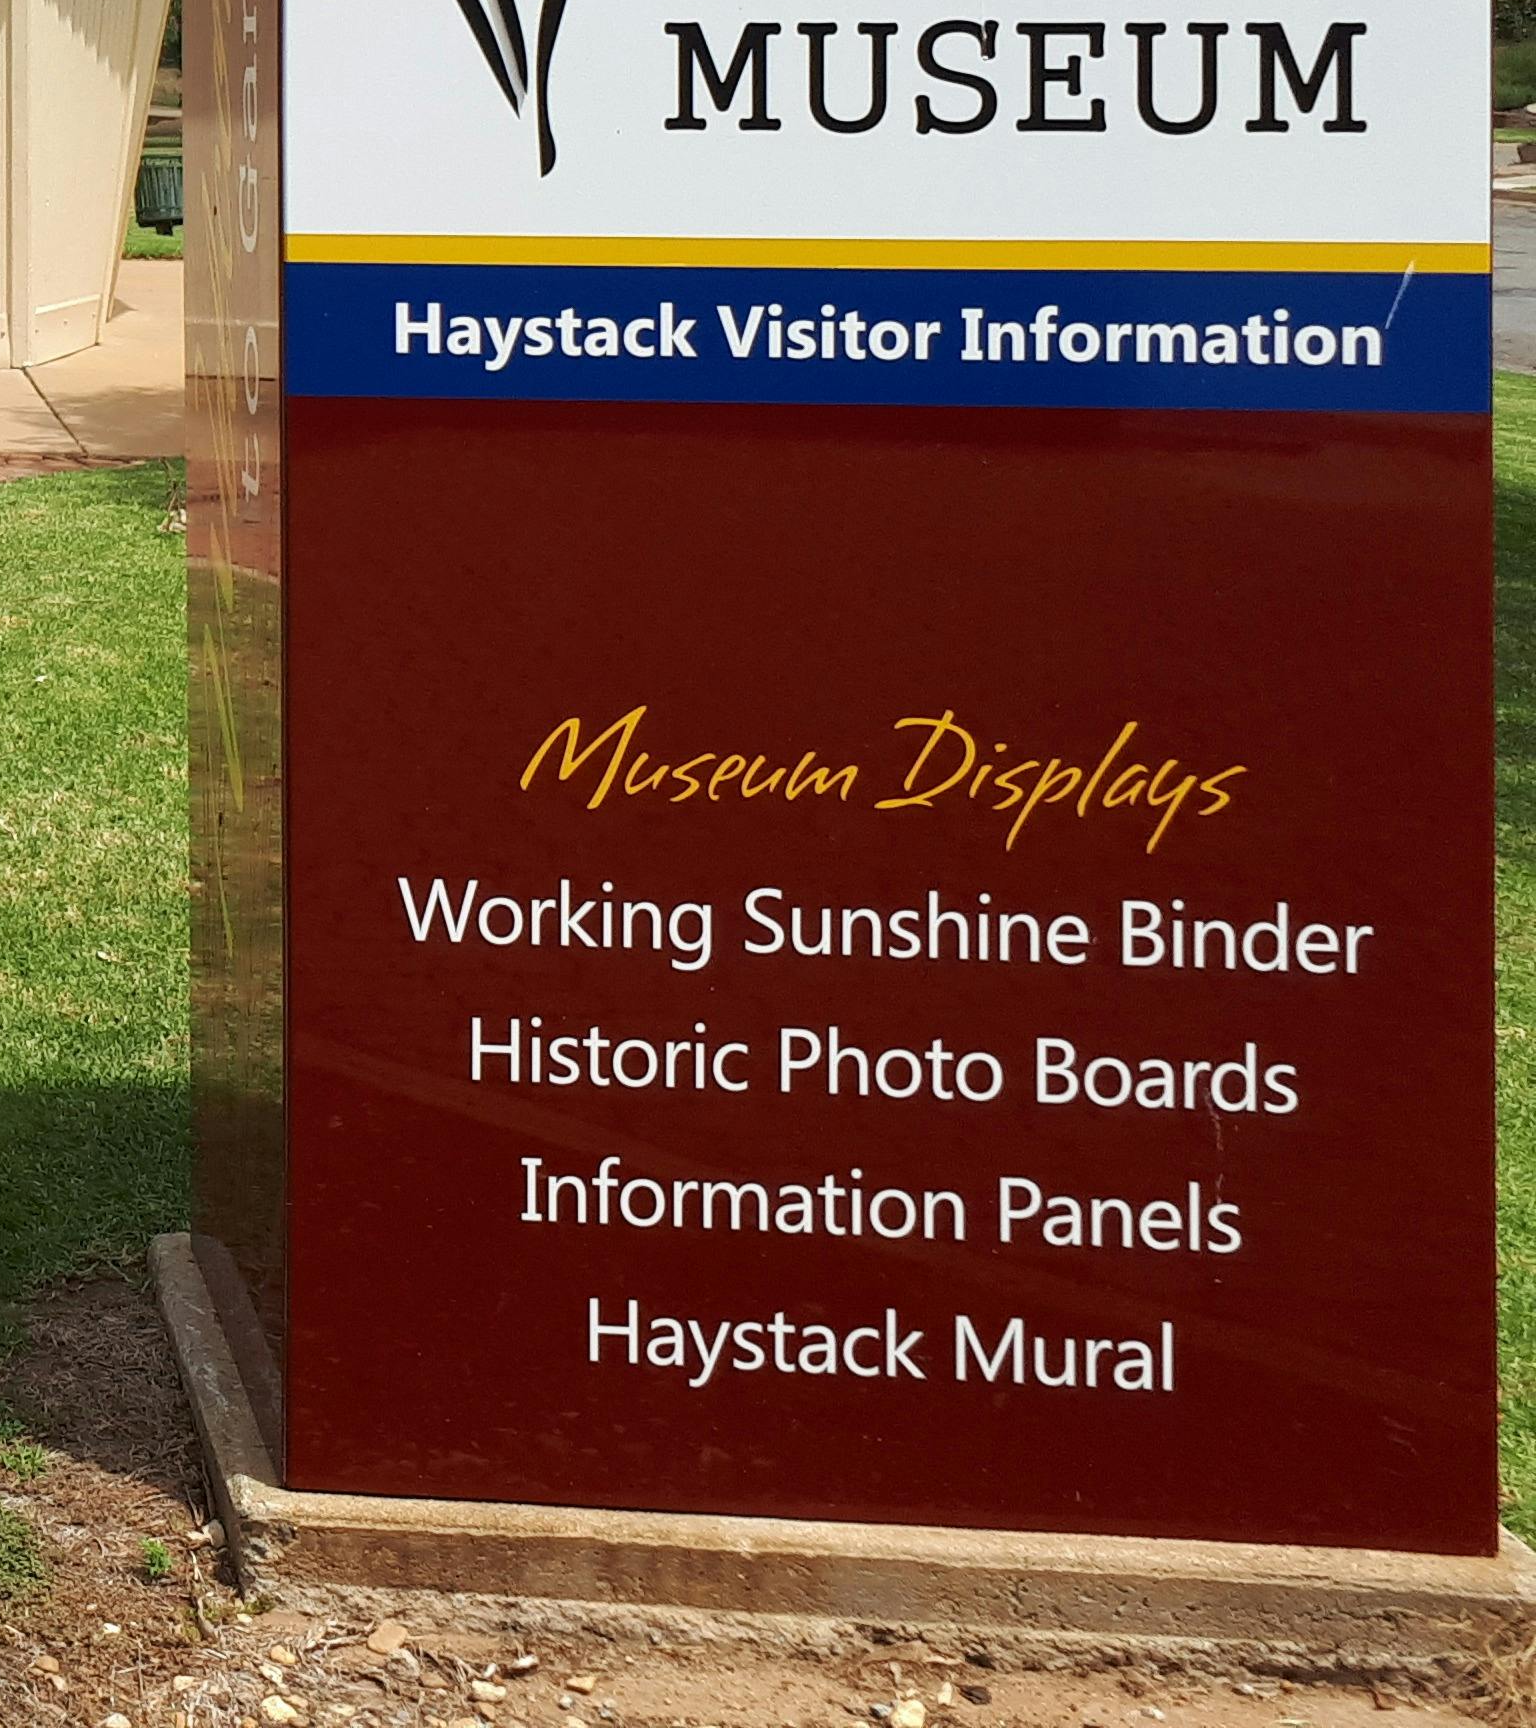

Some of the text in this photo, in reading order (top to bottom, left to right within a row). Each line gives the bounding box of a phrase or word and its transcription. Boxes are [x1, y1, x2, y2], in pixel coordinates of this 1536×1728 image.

[664, 20, 1367, 135] MUSEUM
[396, 303, 1380, 370] Haystack Visitor Information
[240, 324, 262, 502] to
[520, 706, 1247, 853] Museum Displays
[398, 878, 1373, 973] Working Sunshine Binder
[472, 1017, 1298, 1113] Historic Photo Boards
[522, 1157, 1241, 1253] Information Panels
[590, 1298, 1172, 1390] Haystack Mural
